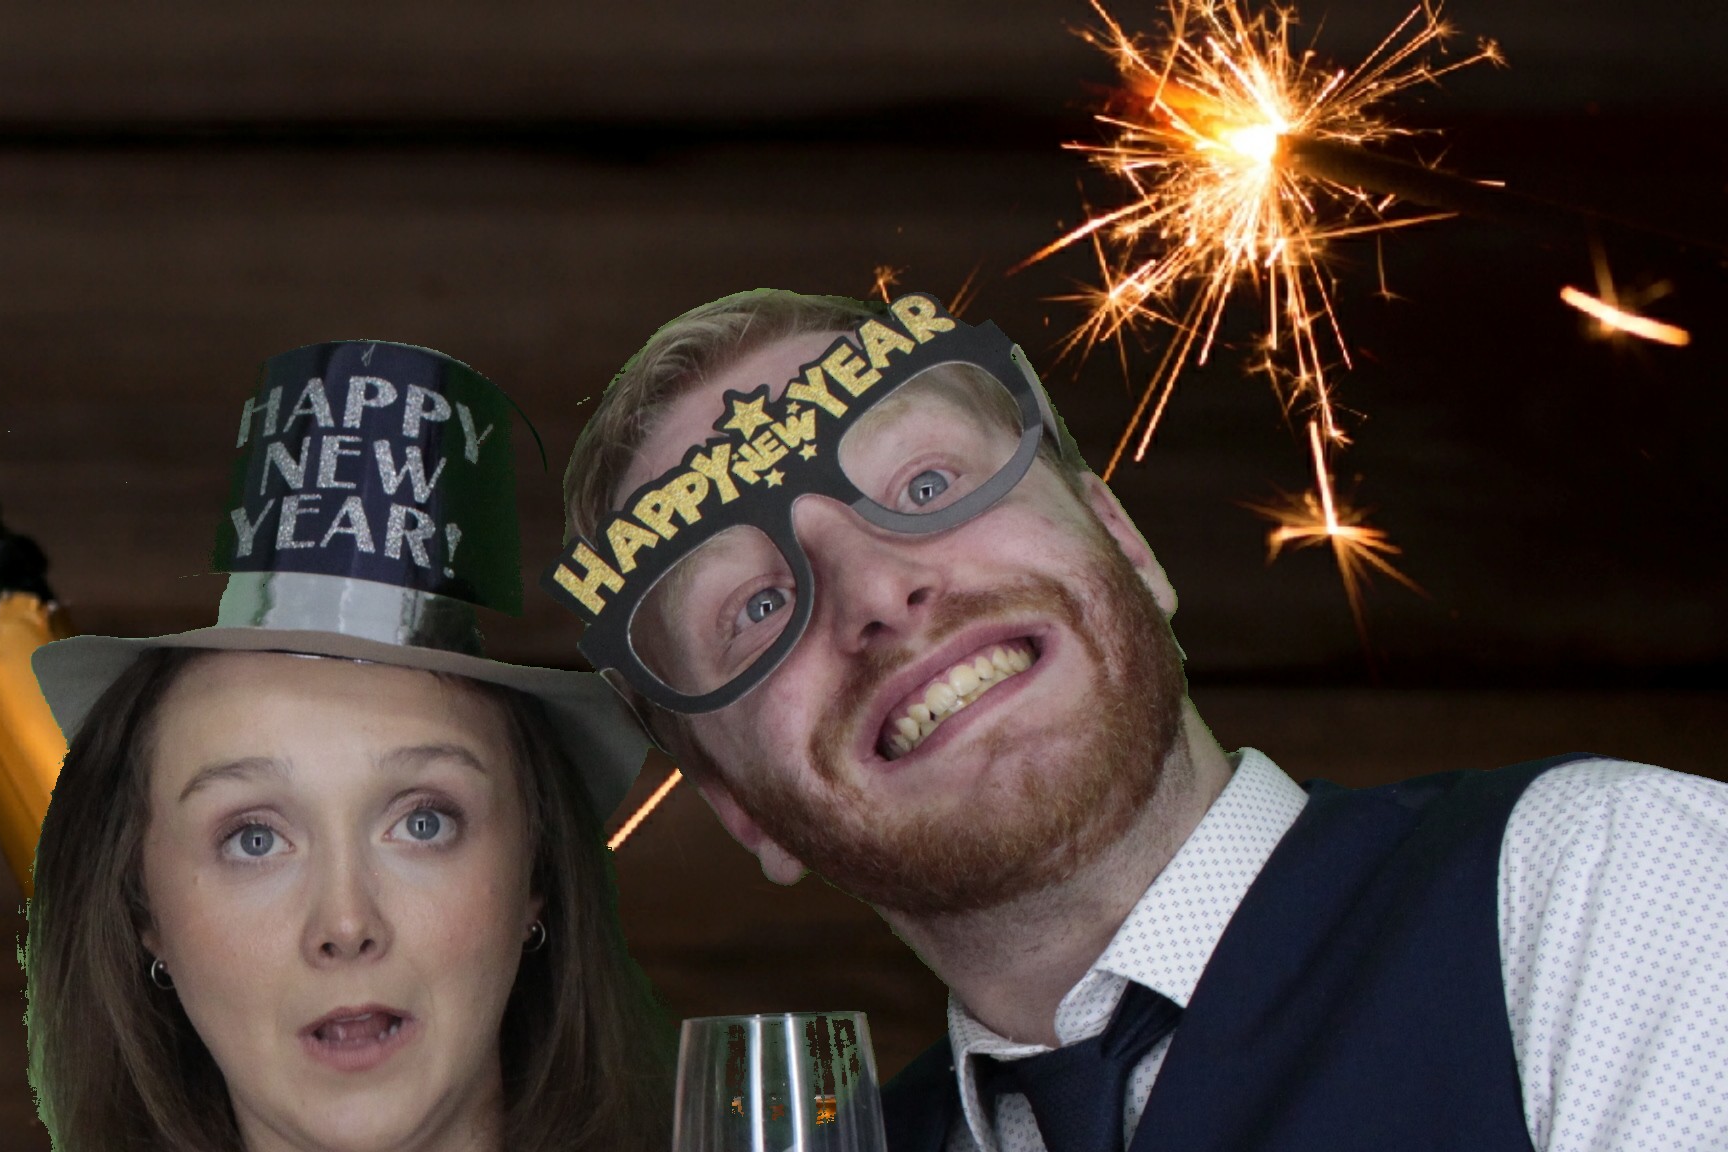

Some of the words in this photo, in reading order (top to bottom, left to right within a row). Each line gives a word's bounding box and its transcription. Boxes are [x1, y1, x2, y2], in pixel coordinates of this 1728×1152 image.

[236, 376, 493, 464] HAPPY
[553, 443, 741, 615] HAPPY
[733, 408, 816, 485] NEW
[787, 295, 956, 418] YEAR
[260, 435, 446, 503] NEW
[230, 494, 462, 578] YEAR!
